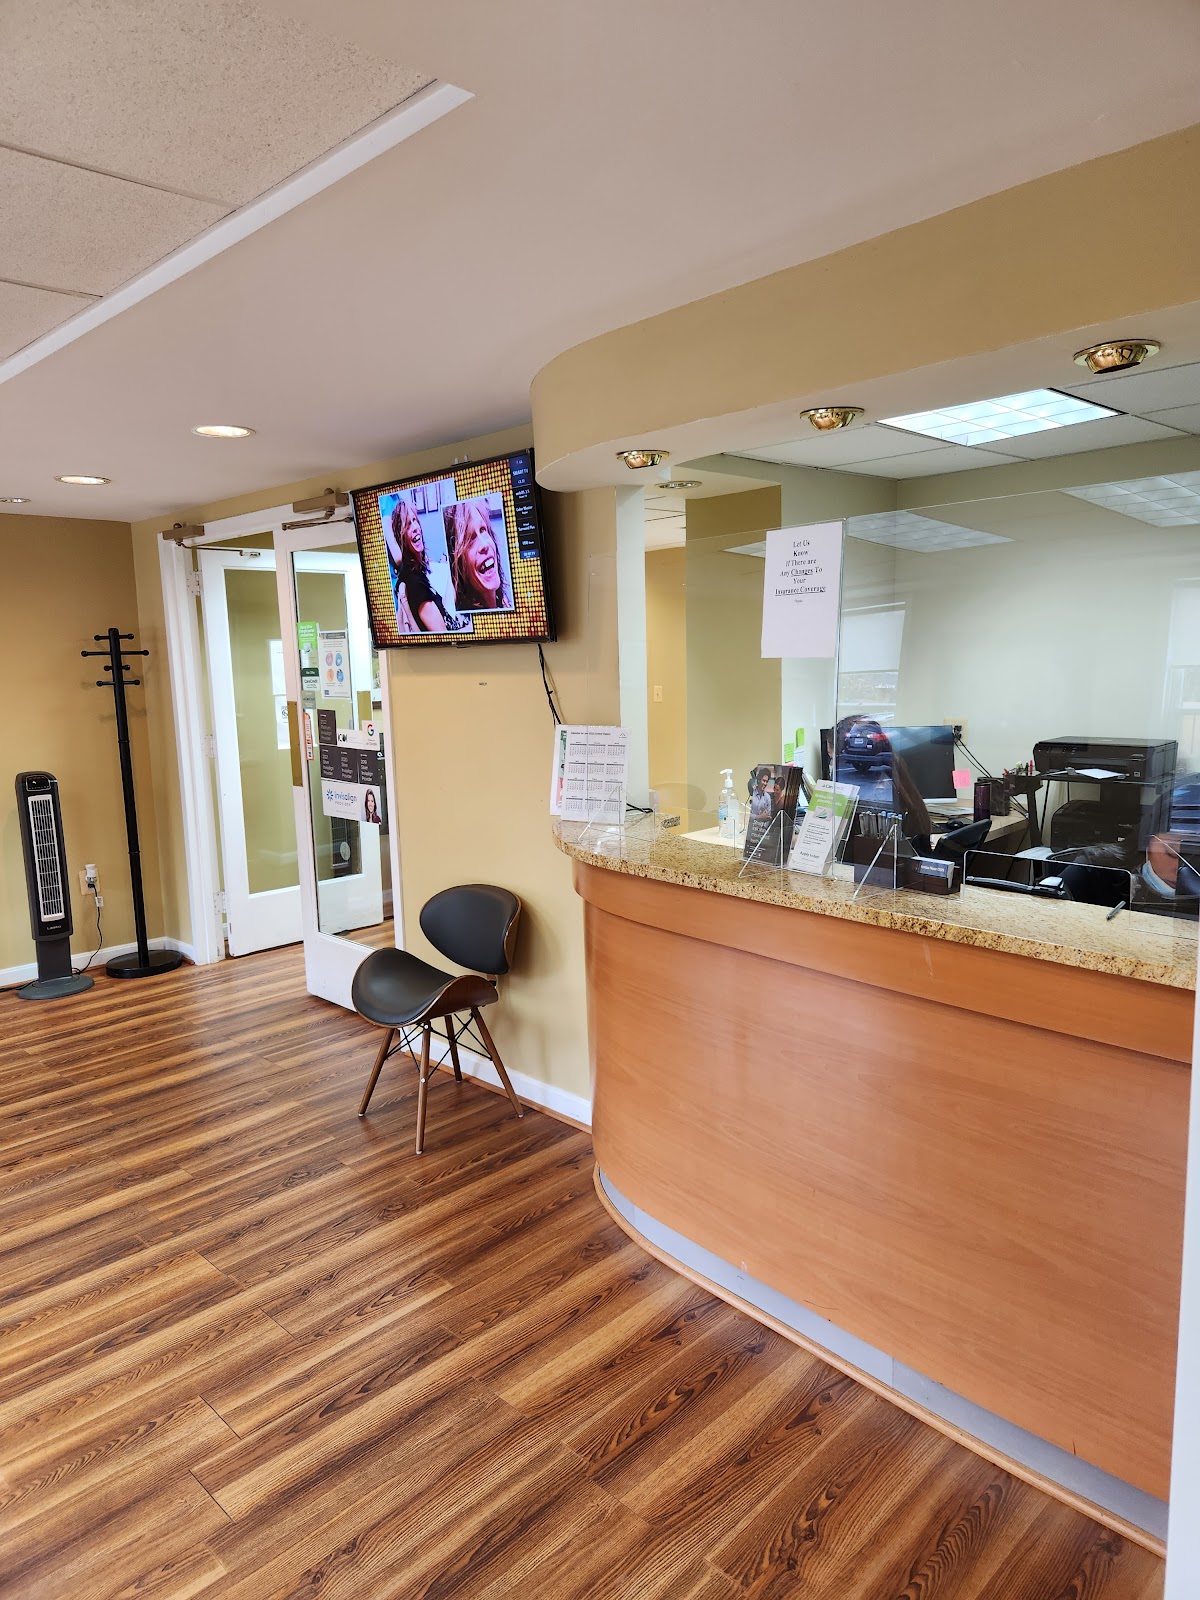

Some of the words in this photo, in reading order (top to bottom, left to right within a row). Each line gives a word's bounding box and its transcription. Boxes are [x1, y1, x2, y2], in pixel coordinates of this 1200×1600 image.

[791, 559, 806, 567] There
[791, 567, 813, 576] Changes
[775, 587, 800, 596] Insurance
[800, 585, 826, 594] Coverage
[367, 723, 375, 737] G
[334, 791, 358, 804] invisalign
